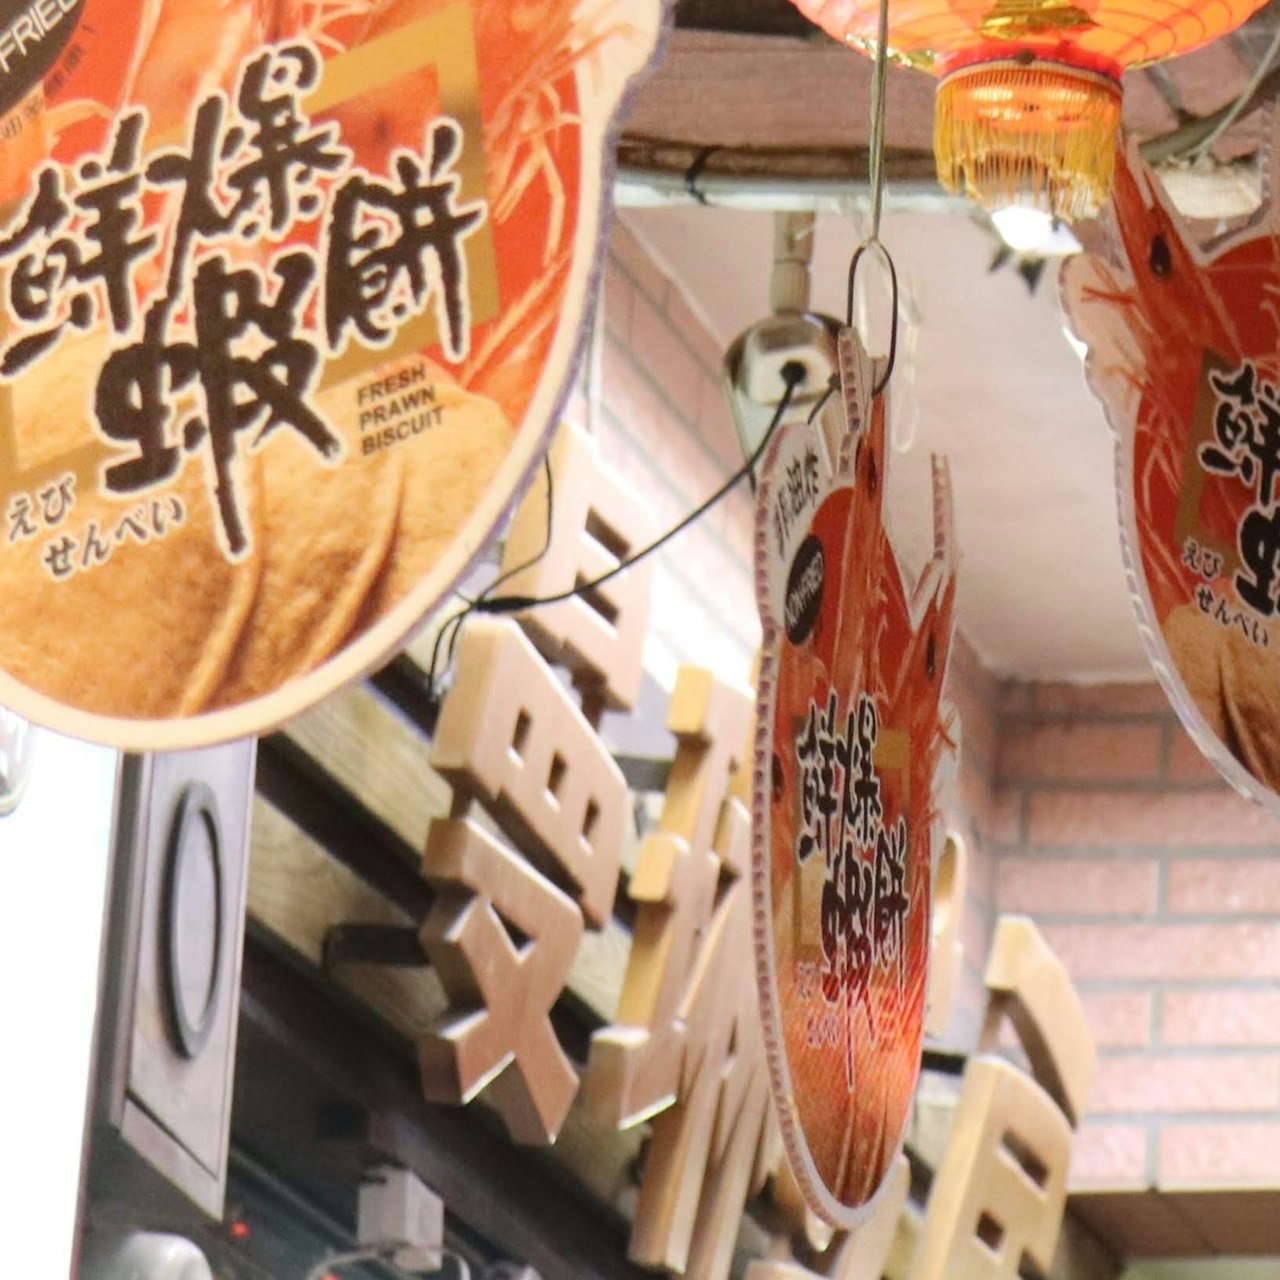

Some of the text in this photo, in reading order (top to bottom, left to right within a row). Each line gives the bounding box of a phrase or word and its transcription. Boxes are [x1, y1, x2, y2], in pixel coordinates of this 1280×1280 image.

[357, 362, 426, 406] FRESH
[359, 383, 436, 430] PRAWN
[361, 405, 445, 456] BISCUIT
[10, 476, 73, 542] えび
[44, 497, 183, 576] せんべい
